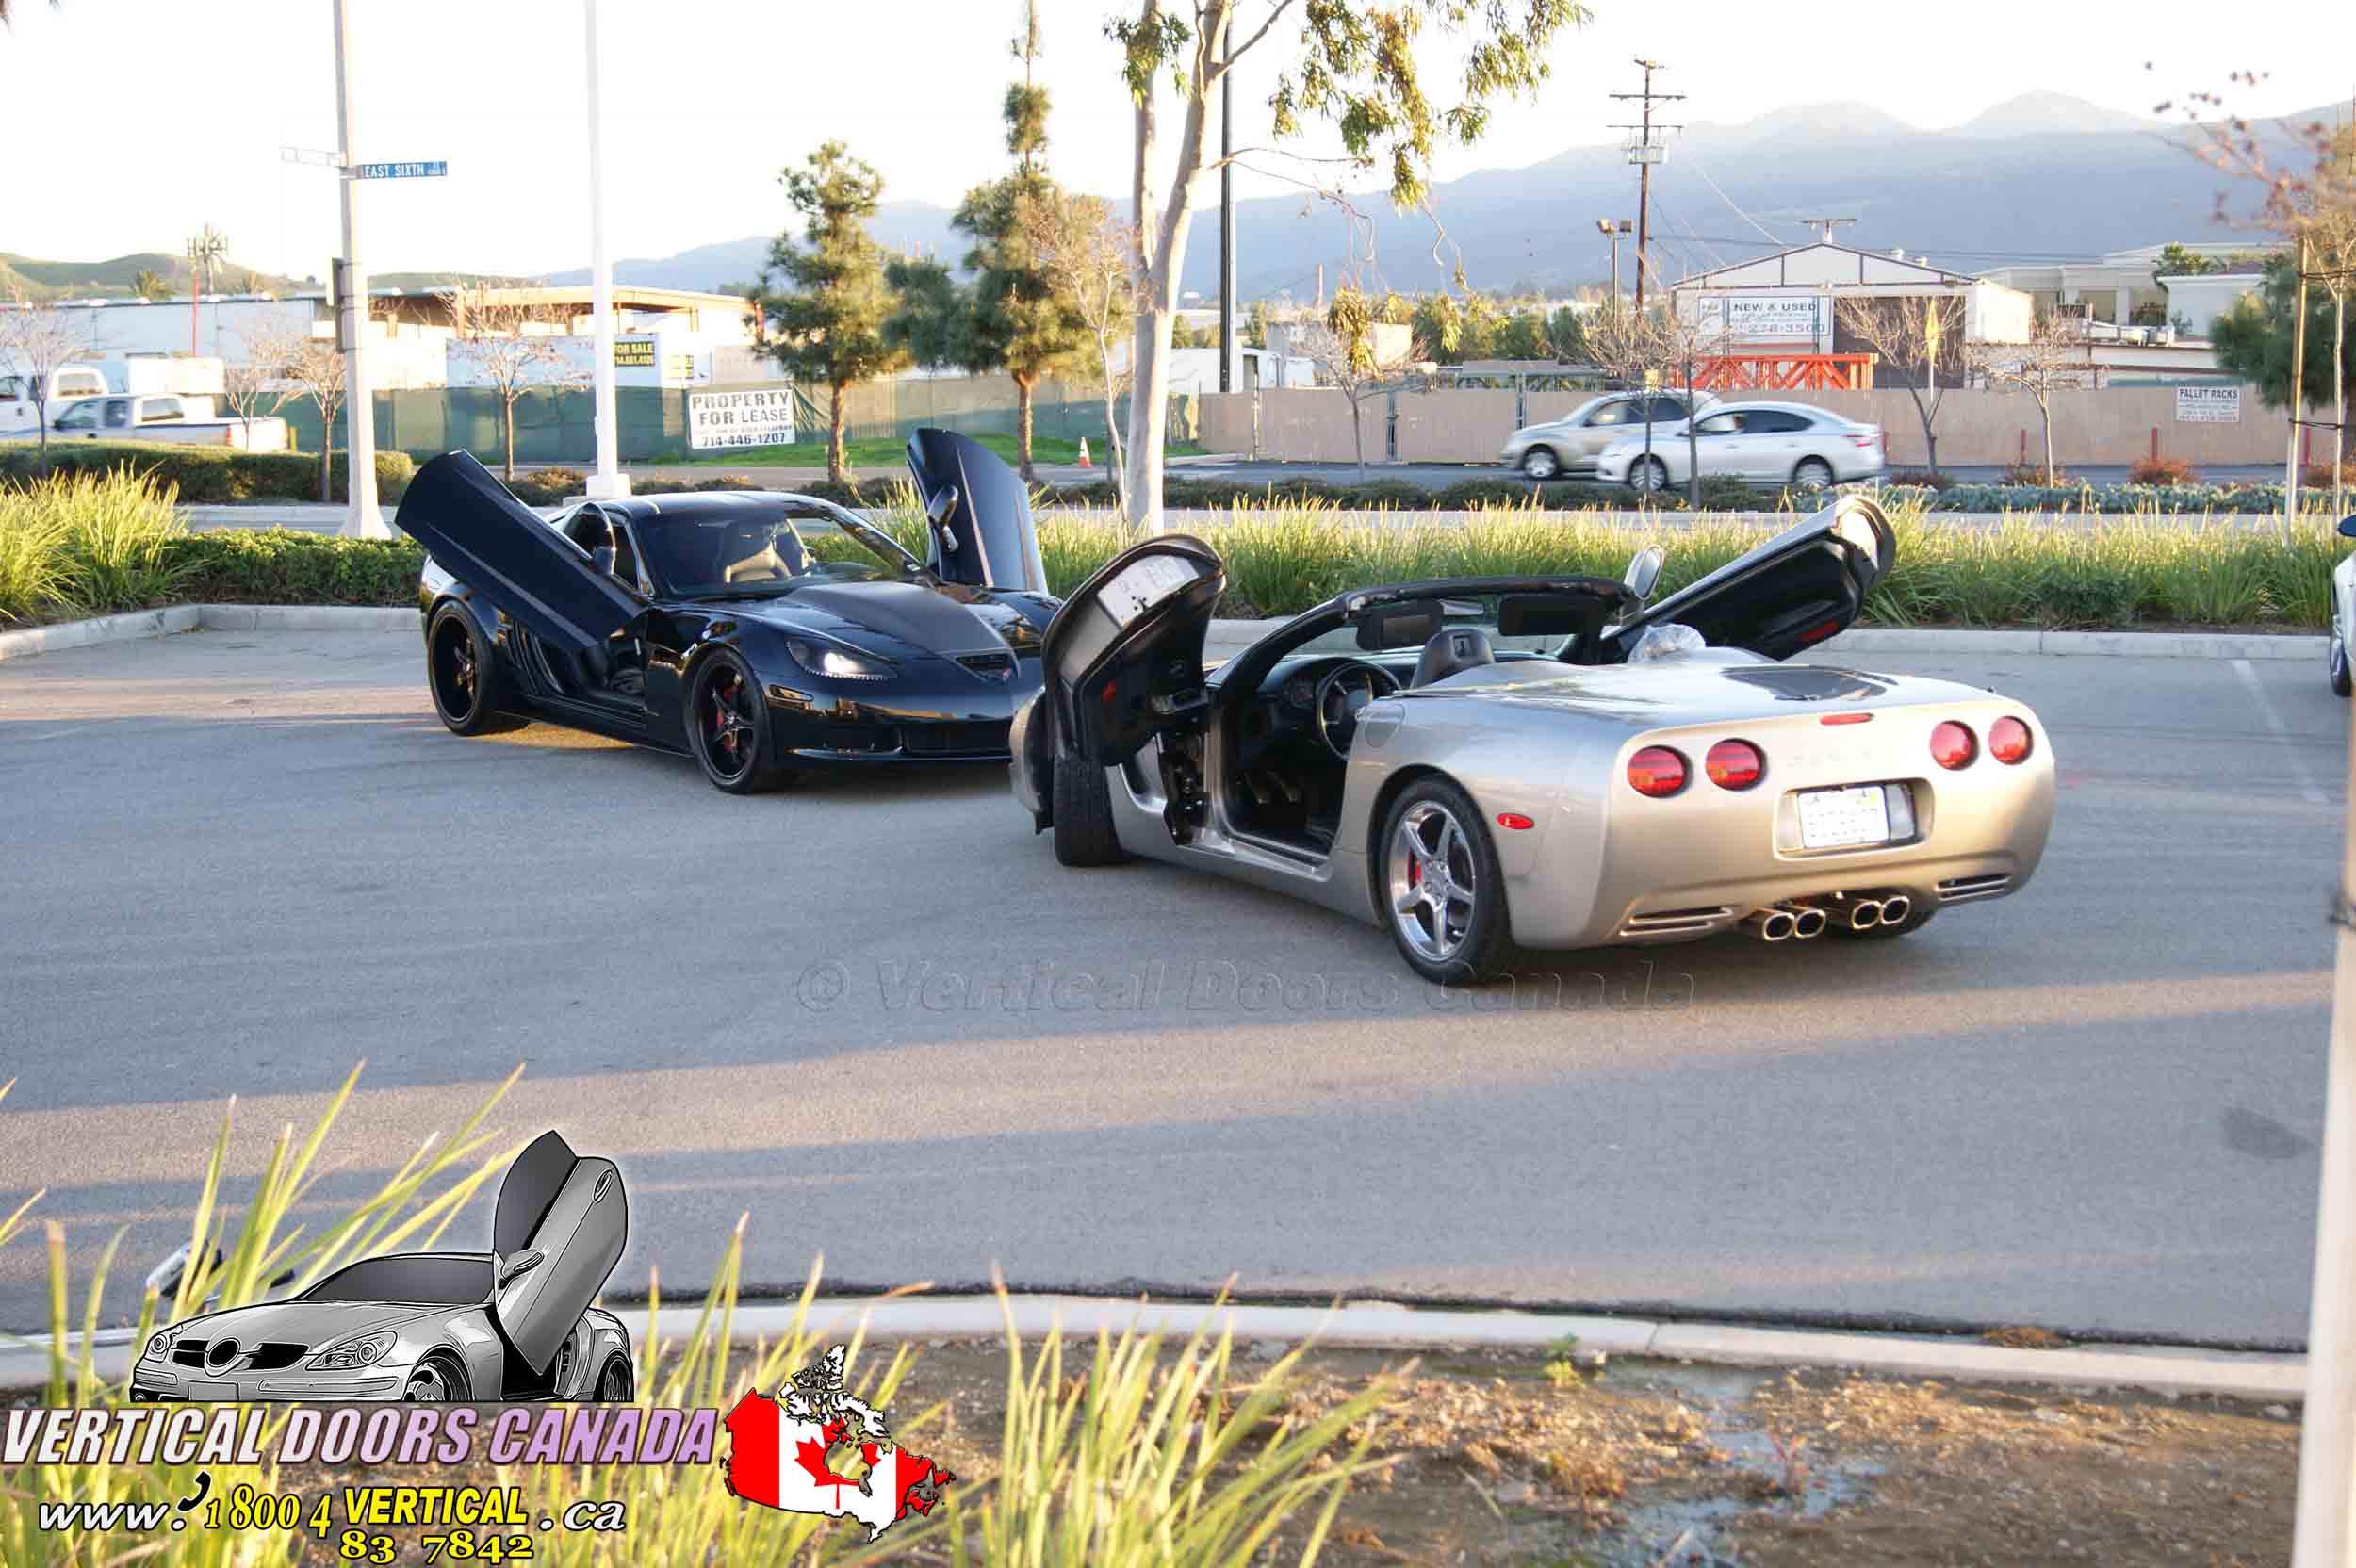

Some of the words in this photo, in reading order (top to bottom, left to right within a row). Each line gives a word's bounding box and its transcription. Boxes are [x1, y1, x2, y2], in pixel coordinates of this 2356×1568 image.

[365, 164, 390, 178] EAST
[395, 162, 424, 177] SIXTH
[1734, 302, 1763, 311] NEW
[1782, 302, 1816, 311] USED
[631, 342, 654, 354] SALE
[692, 391, 789, 410] PROPERTY
[2180, 388, 2208, 399] PALLET
[2211, 389, 2238, 400] RACKS
[699, 411, 735, 426] FOR
[741, 408, 789, 423] LEASE
[702, 433, 786, 447] 714-446-1207
